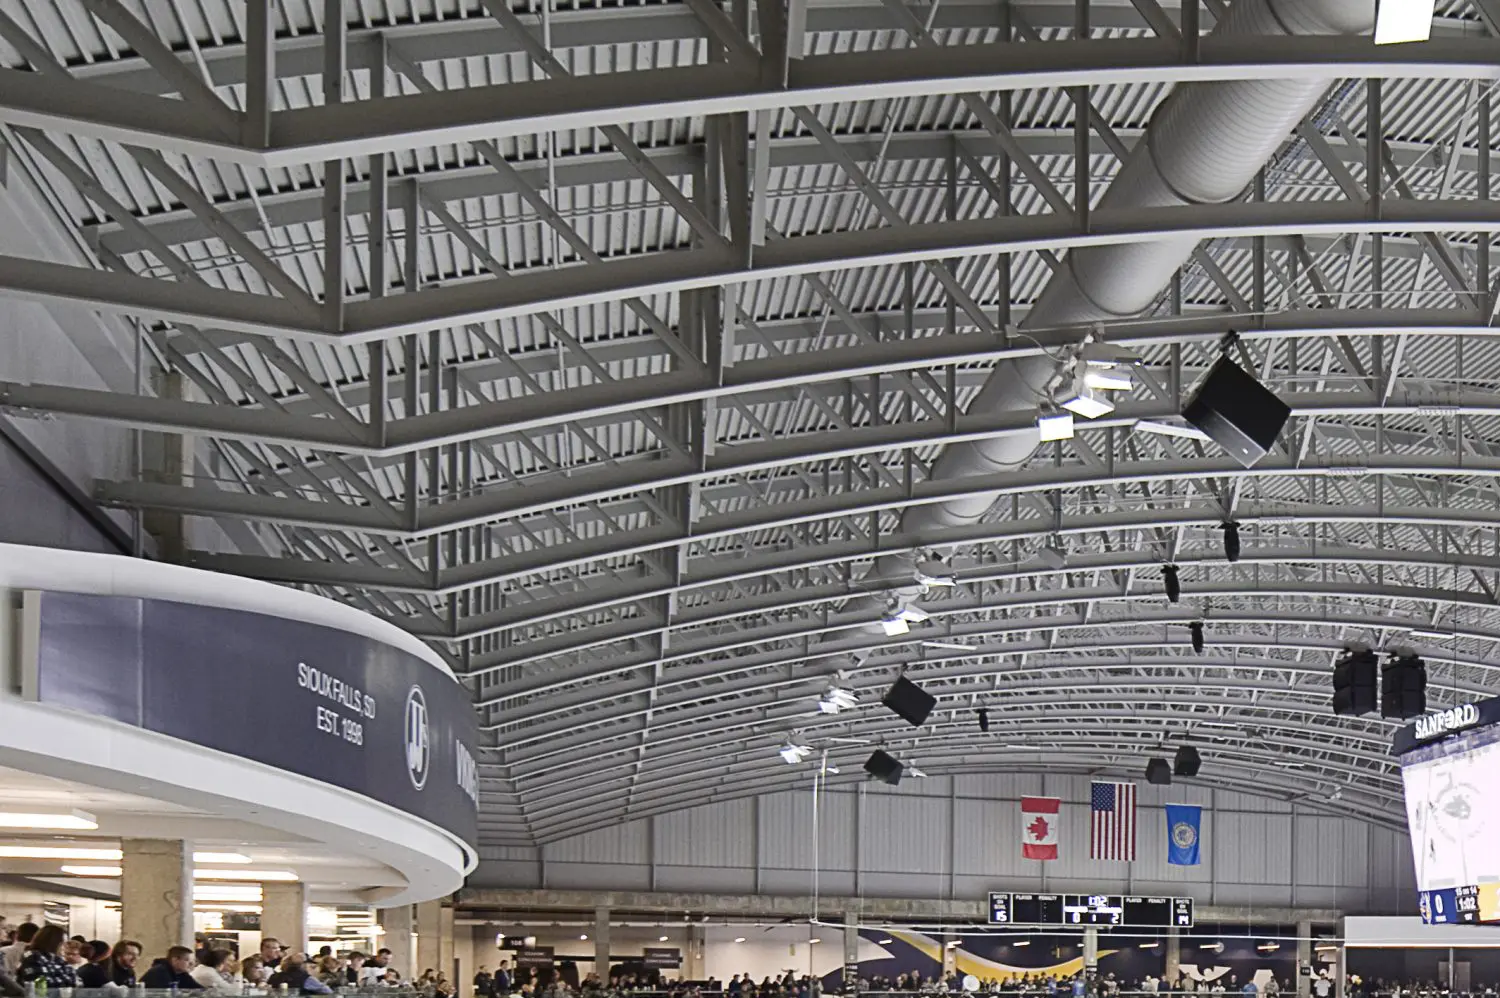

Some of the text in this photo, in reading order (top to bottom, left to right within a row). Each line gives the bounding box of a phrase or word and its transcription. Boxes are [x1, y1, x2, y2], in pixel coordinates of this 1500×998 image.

[298, 663, 376, 720] SIOUX FALLS, SD
[316, 706, 364, 746] EST. 1998
[1415, 703, 1479, 740] SANFORD
[1435, 894, 1444, 914] 0
[1459, 897, 1477, 910] 1:02
[1111, 912, 1120, 924] 2
